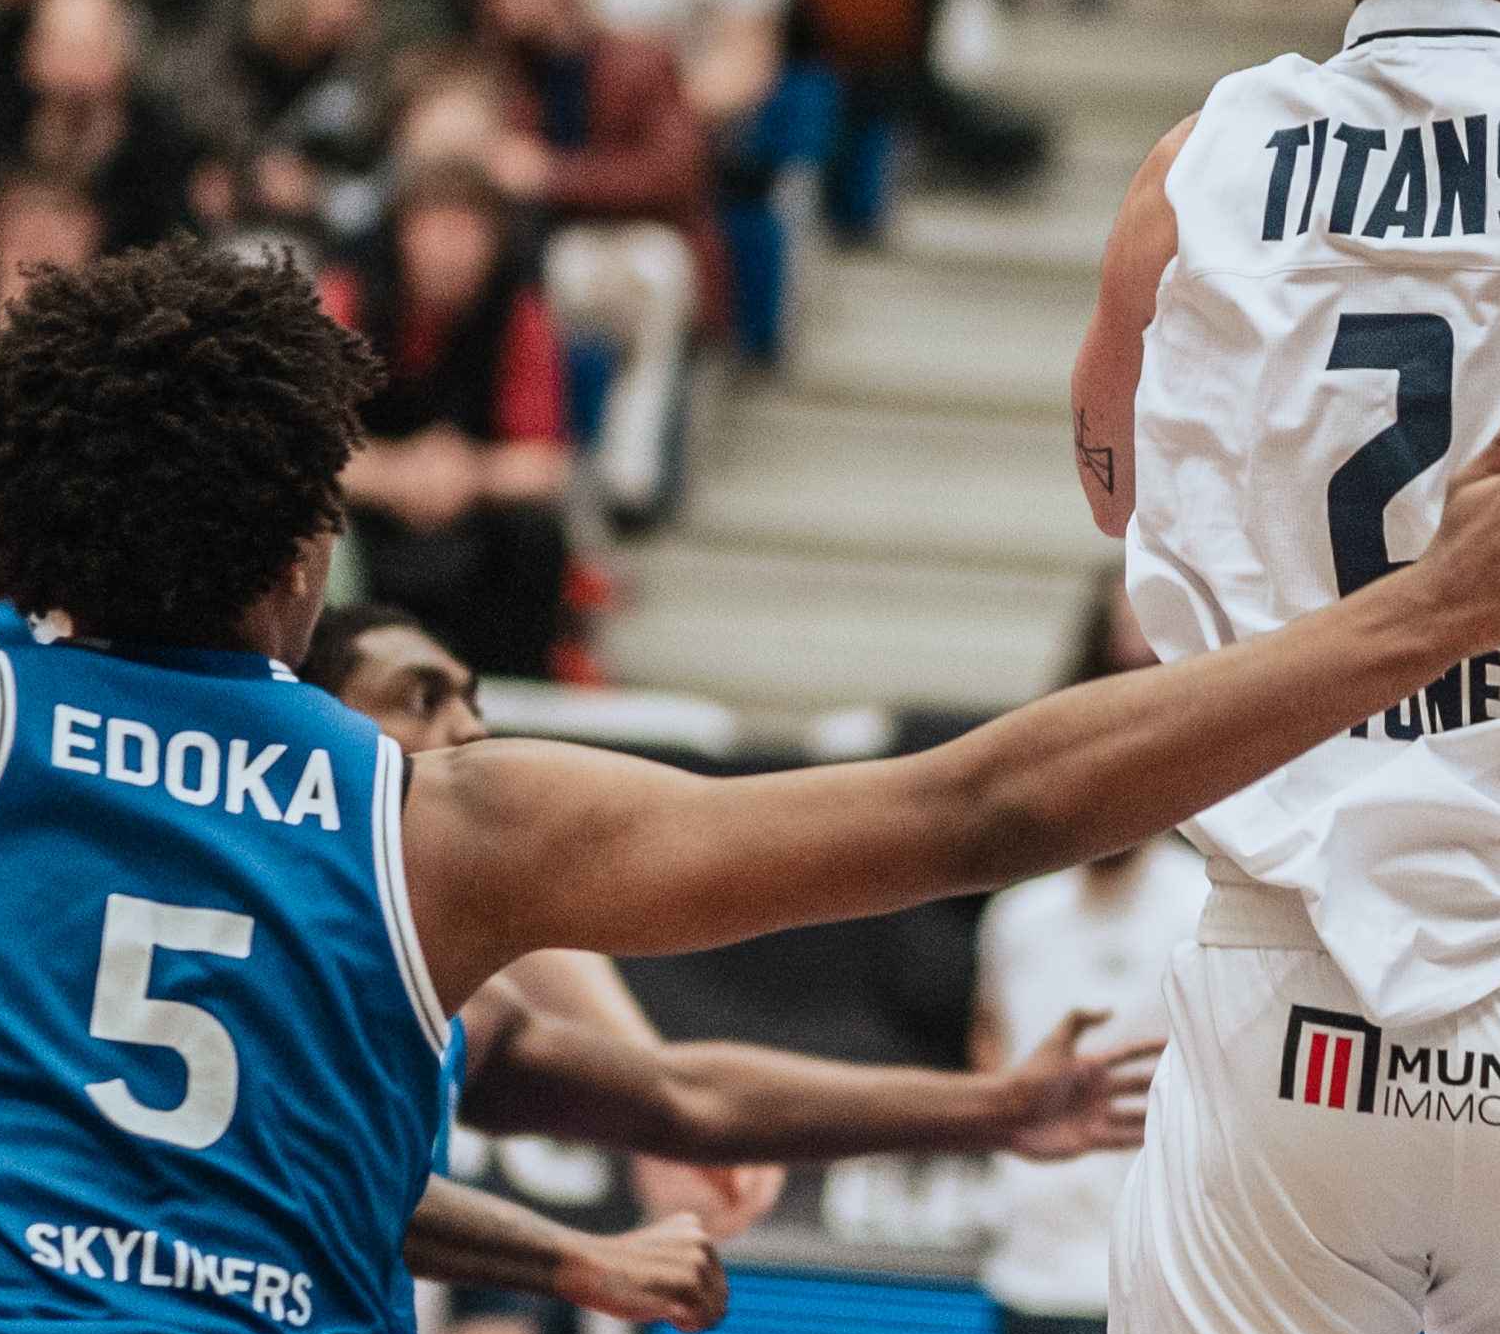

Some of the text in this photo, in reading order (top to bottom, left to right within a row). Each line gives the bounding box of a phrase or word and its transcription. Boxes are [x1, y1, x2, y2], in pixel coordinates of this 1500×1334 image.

[1323, 311, 1454, 601] 2
[49, 703, 342, 833] EDOKA
[84, 891, 256, 1150] 5
[25, 1222, 313, 1327] SKYLINERS
